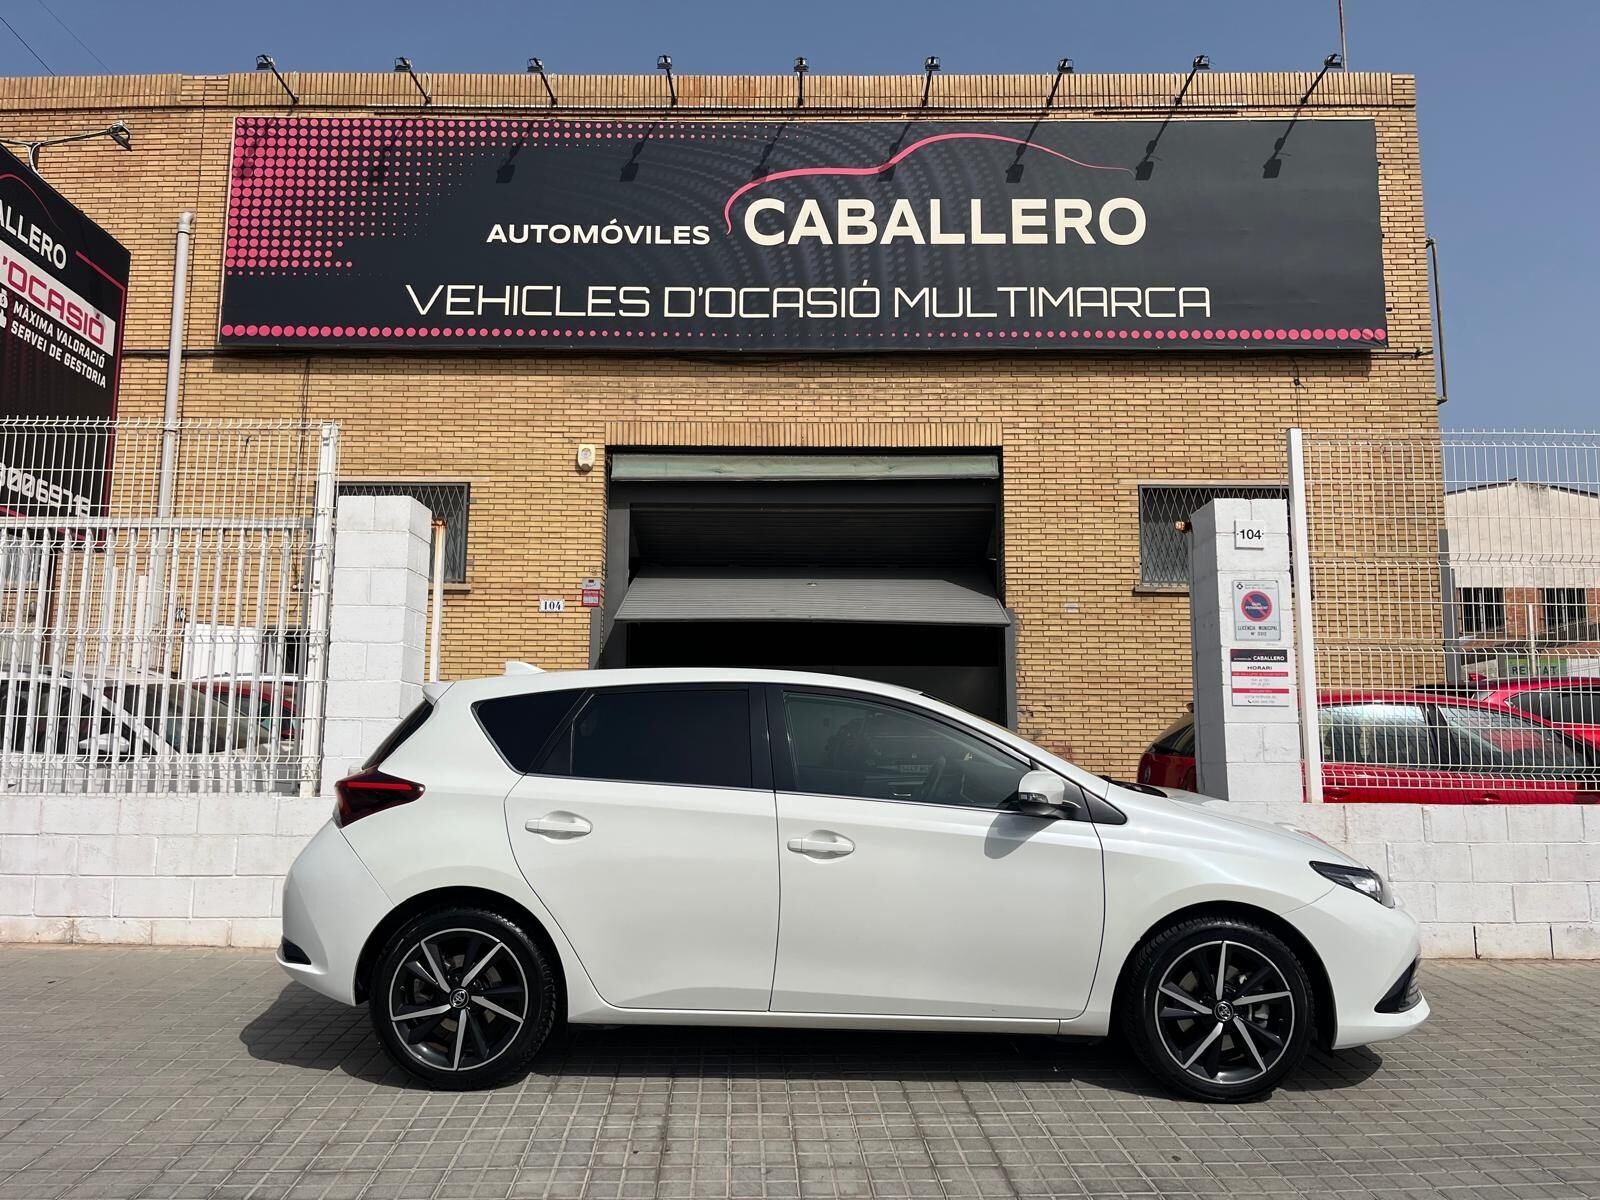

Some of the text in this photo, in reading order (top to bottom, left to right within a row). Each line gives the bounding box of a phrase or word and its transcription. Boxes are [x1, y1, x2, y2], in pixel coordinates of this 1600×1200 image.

[487, 197, 1147, 247] AUTOMÓVILES CABALLERO
[405, 279, 1211, 319] VEHICLES D'OCASIÓ MULTIMARCA
[11, 320, 106, 388] SERVEI DE GESTORIA
[13, 300, 105, 369] MÀXIMA VALORACIÓ
[1239, 529, 1262, 540] 104
[544, 601, 561, 610] 104
